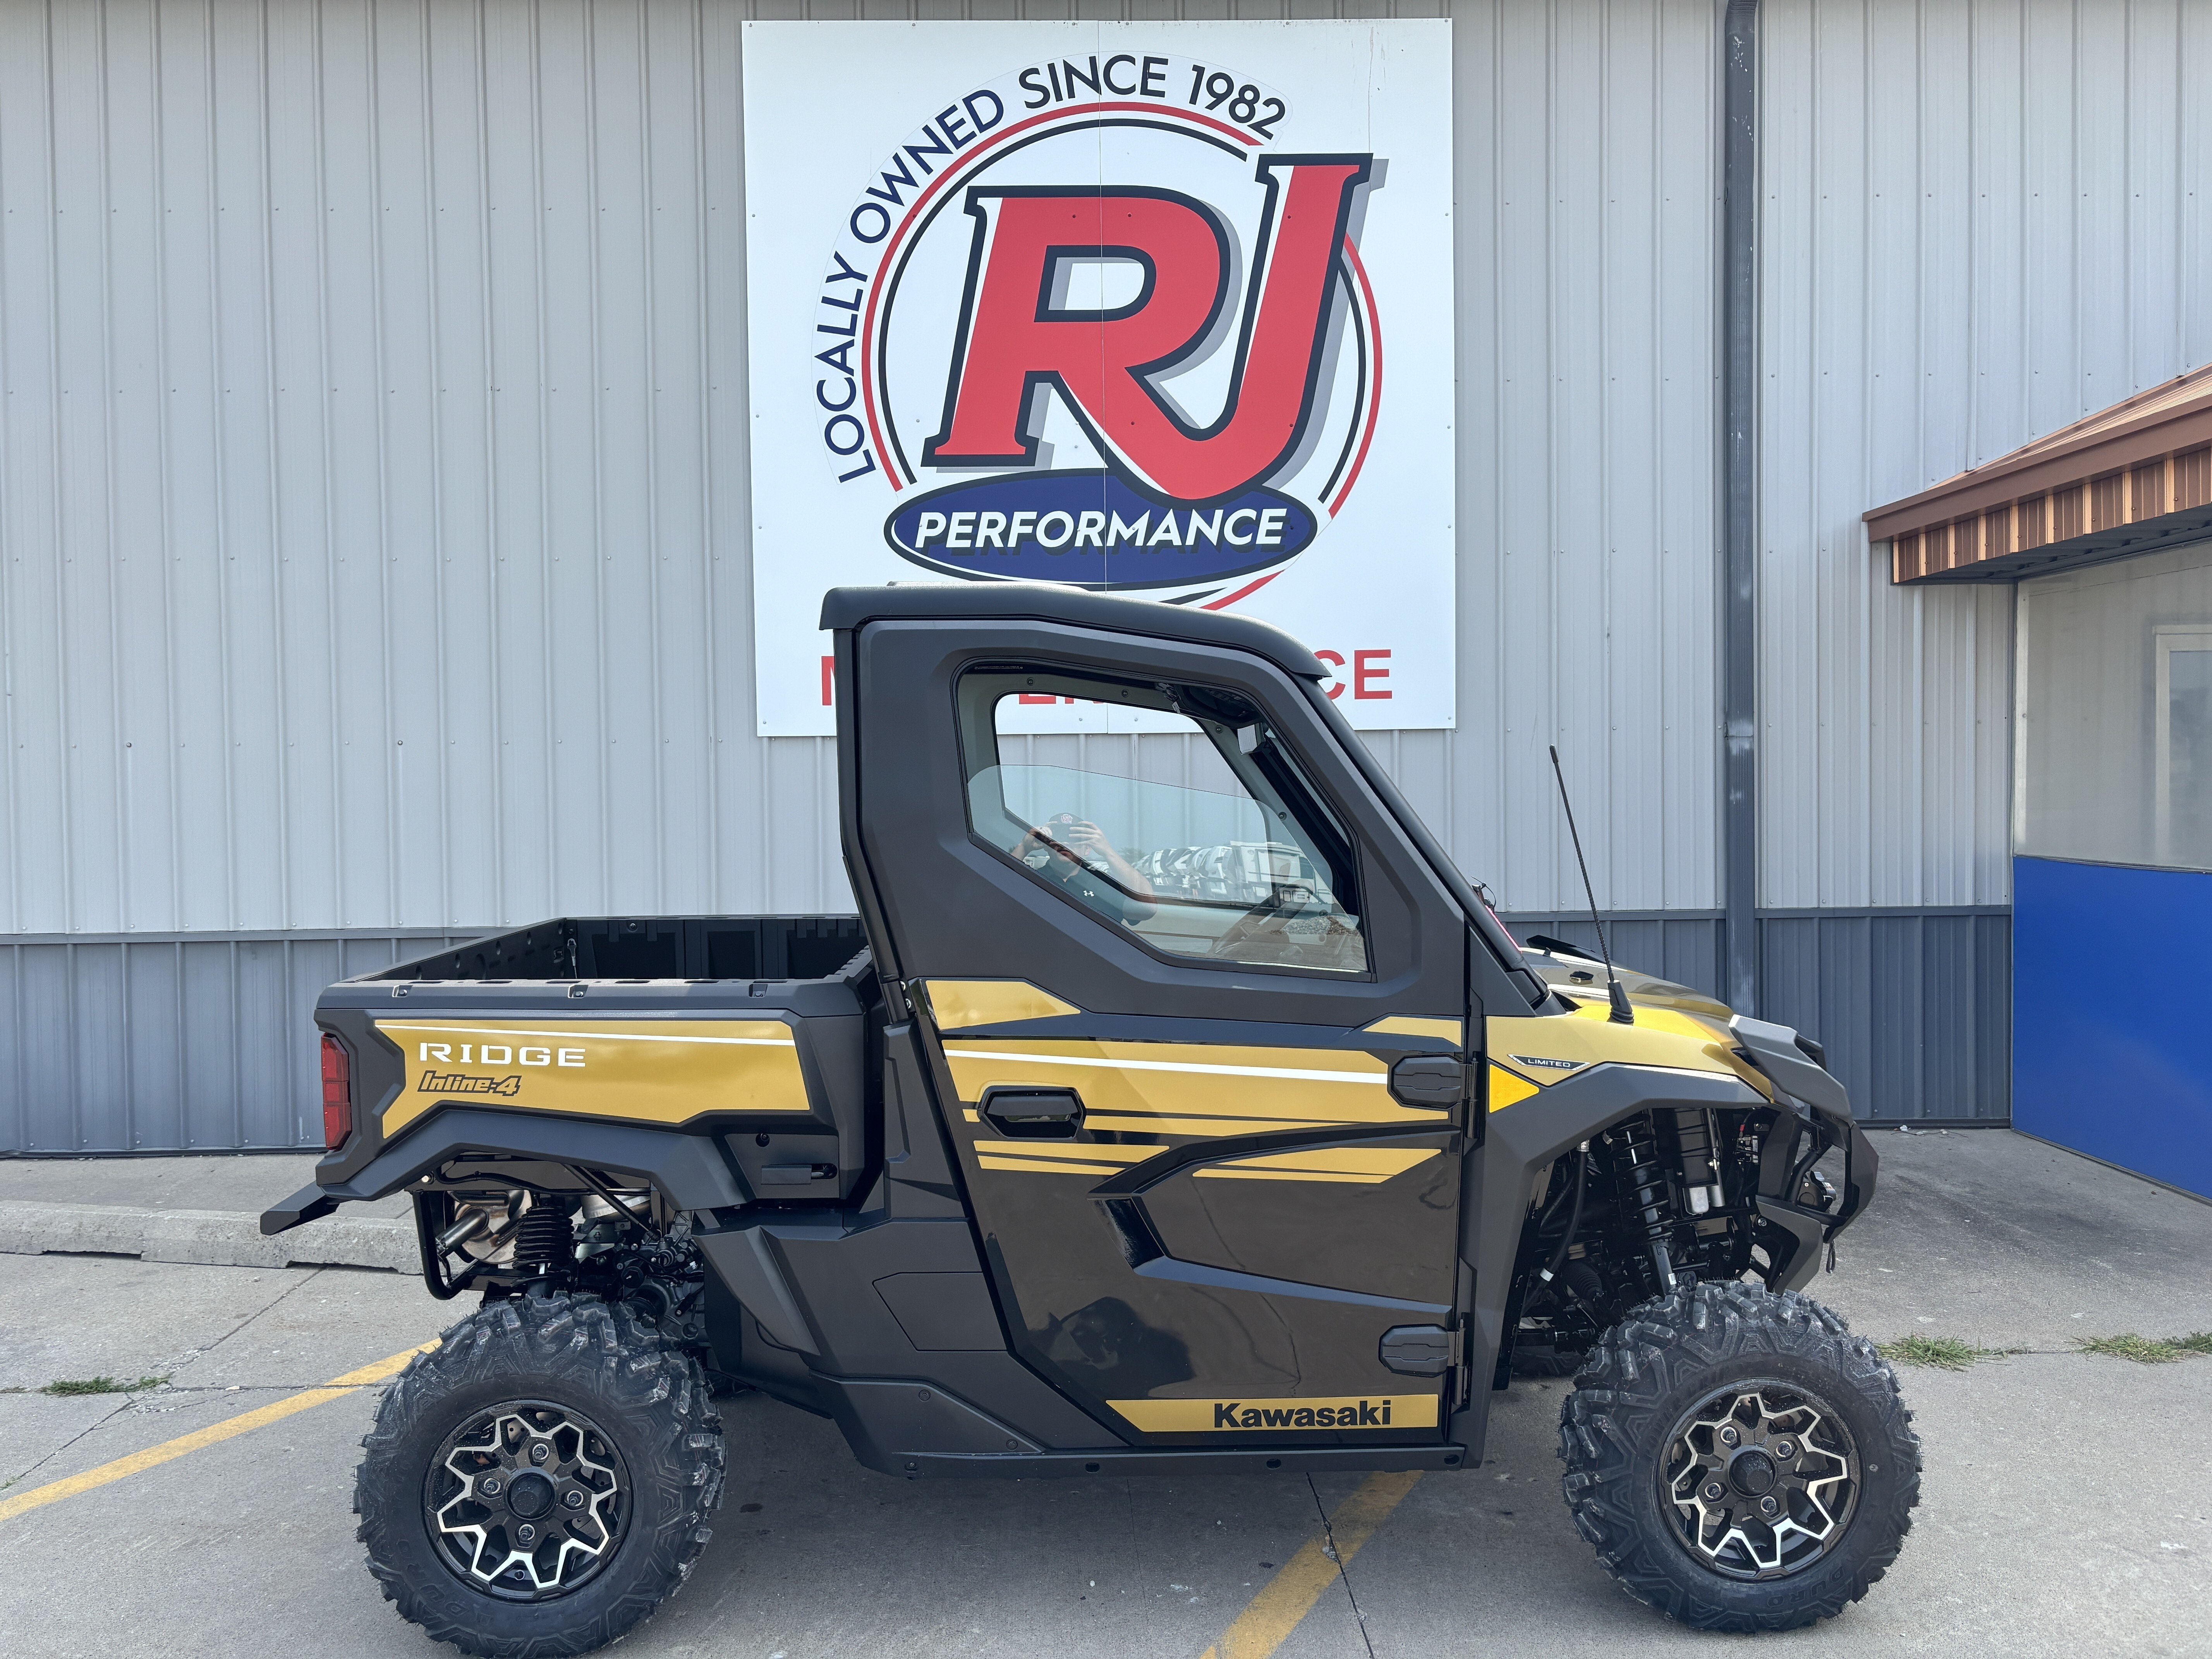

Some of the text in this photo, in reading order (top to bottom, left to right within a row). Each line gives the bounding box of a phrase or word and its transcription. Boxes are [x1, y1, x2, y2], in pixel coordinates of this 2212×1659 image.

[814, 54, 1285, 483] LOCALLY OWNED SINCE 1982
[921, 153, 1375, 508] RJ
[915, 508, 1288, 551] PERFORMANCE
[420, 1042, 586, 1067] RIDGE
[1528, 1058, 1570, 1068] LIMITED
[417, 1070, 522, 1097] Inline-4
[1214, 1399, 1391, 1428] Kawasaki
[1767, 1565, 1845, 1608] DURO
